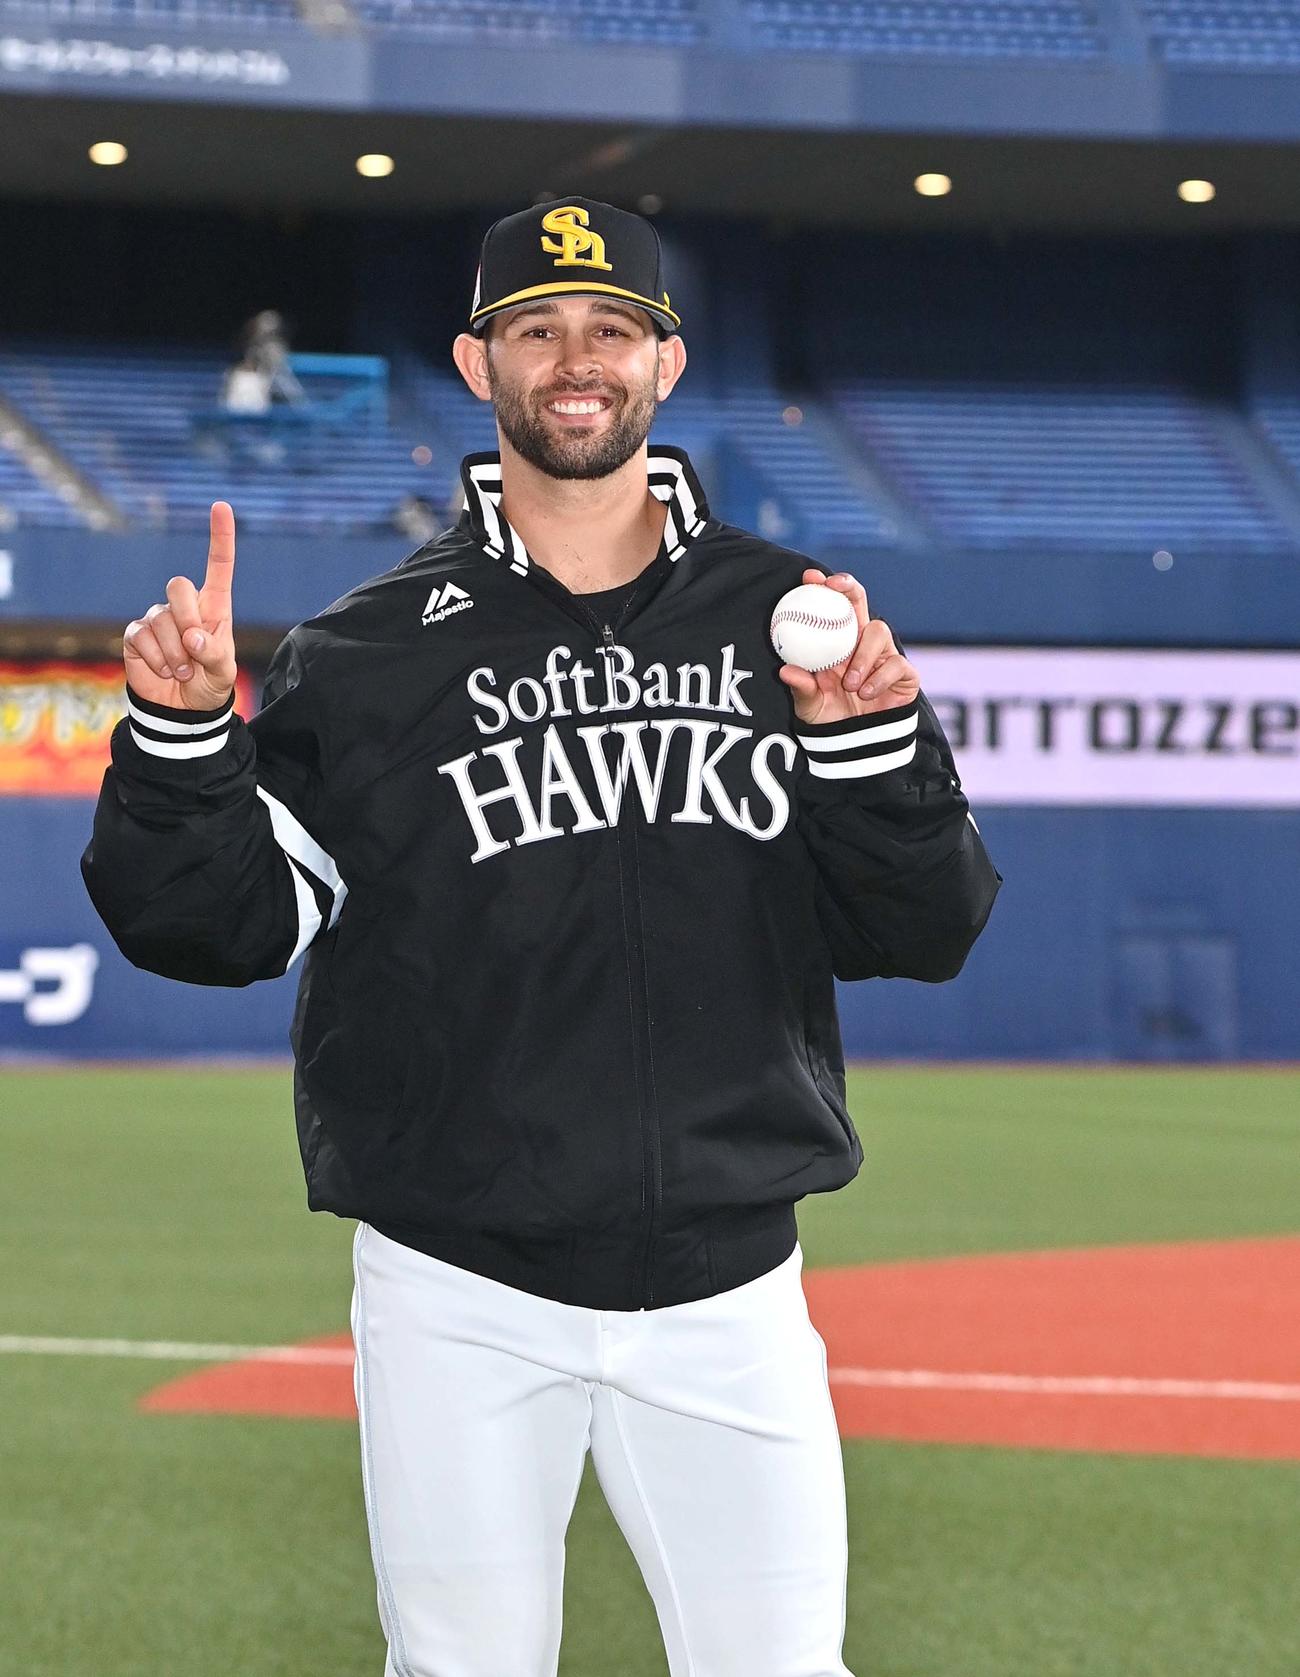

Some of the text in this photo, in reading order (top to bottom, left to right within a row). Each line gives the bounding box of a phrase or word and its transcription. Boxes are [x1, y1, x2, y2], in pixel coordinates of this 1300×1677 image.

[421, 600, 475, 626] Majestic
[466, 643, 754, 735] SoftBank
[436, 718, 798, 864] HAWKS
